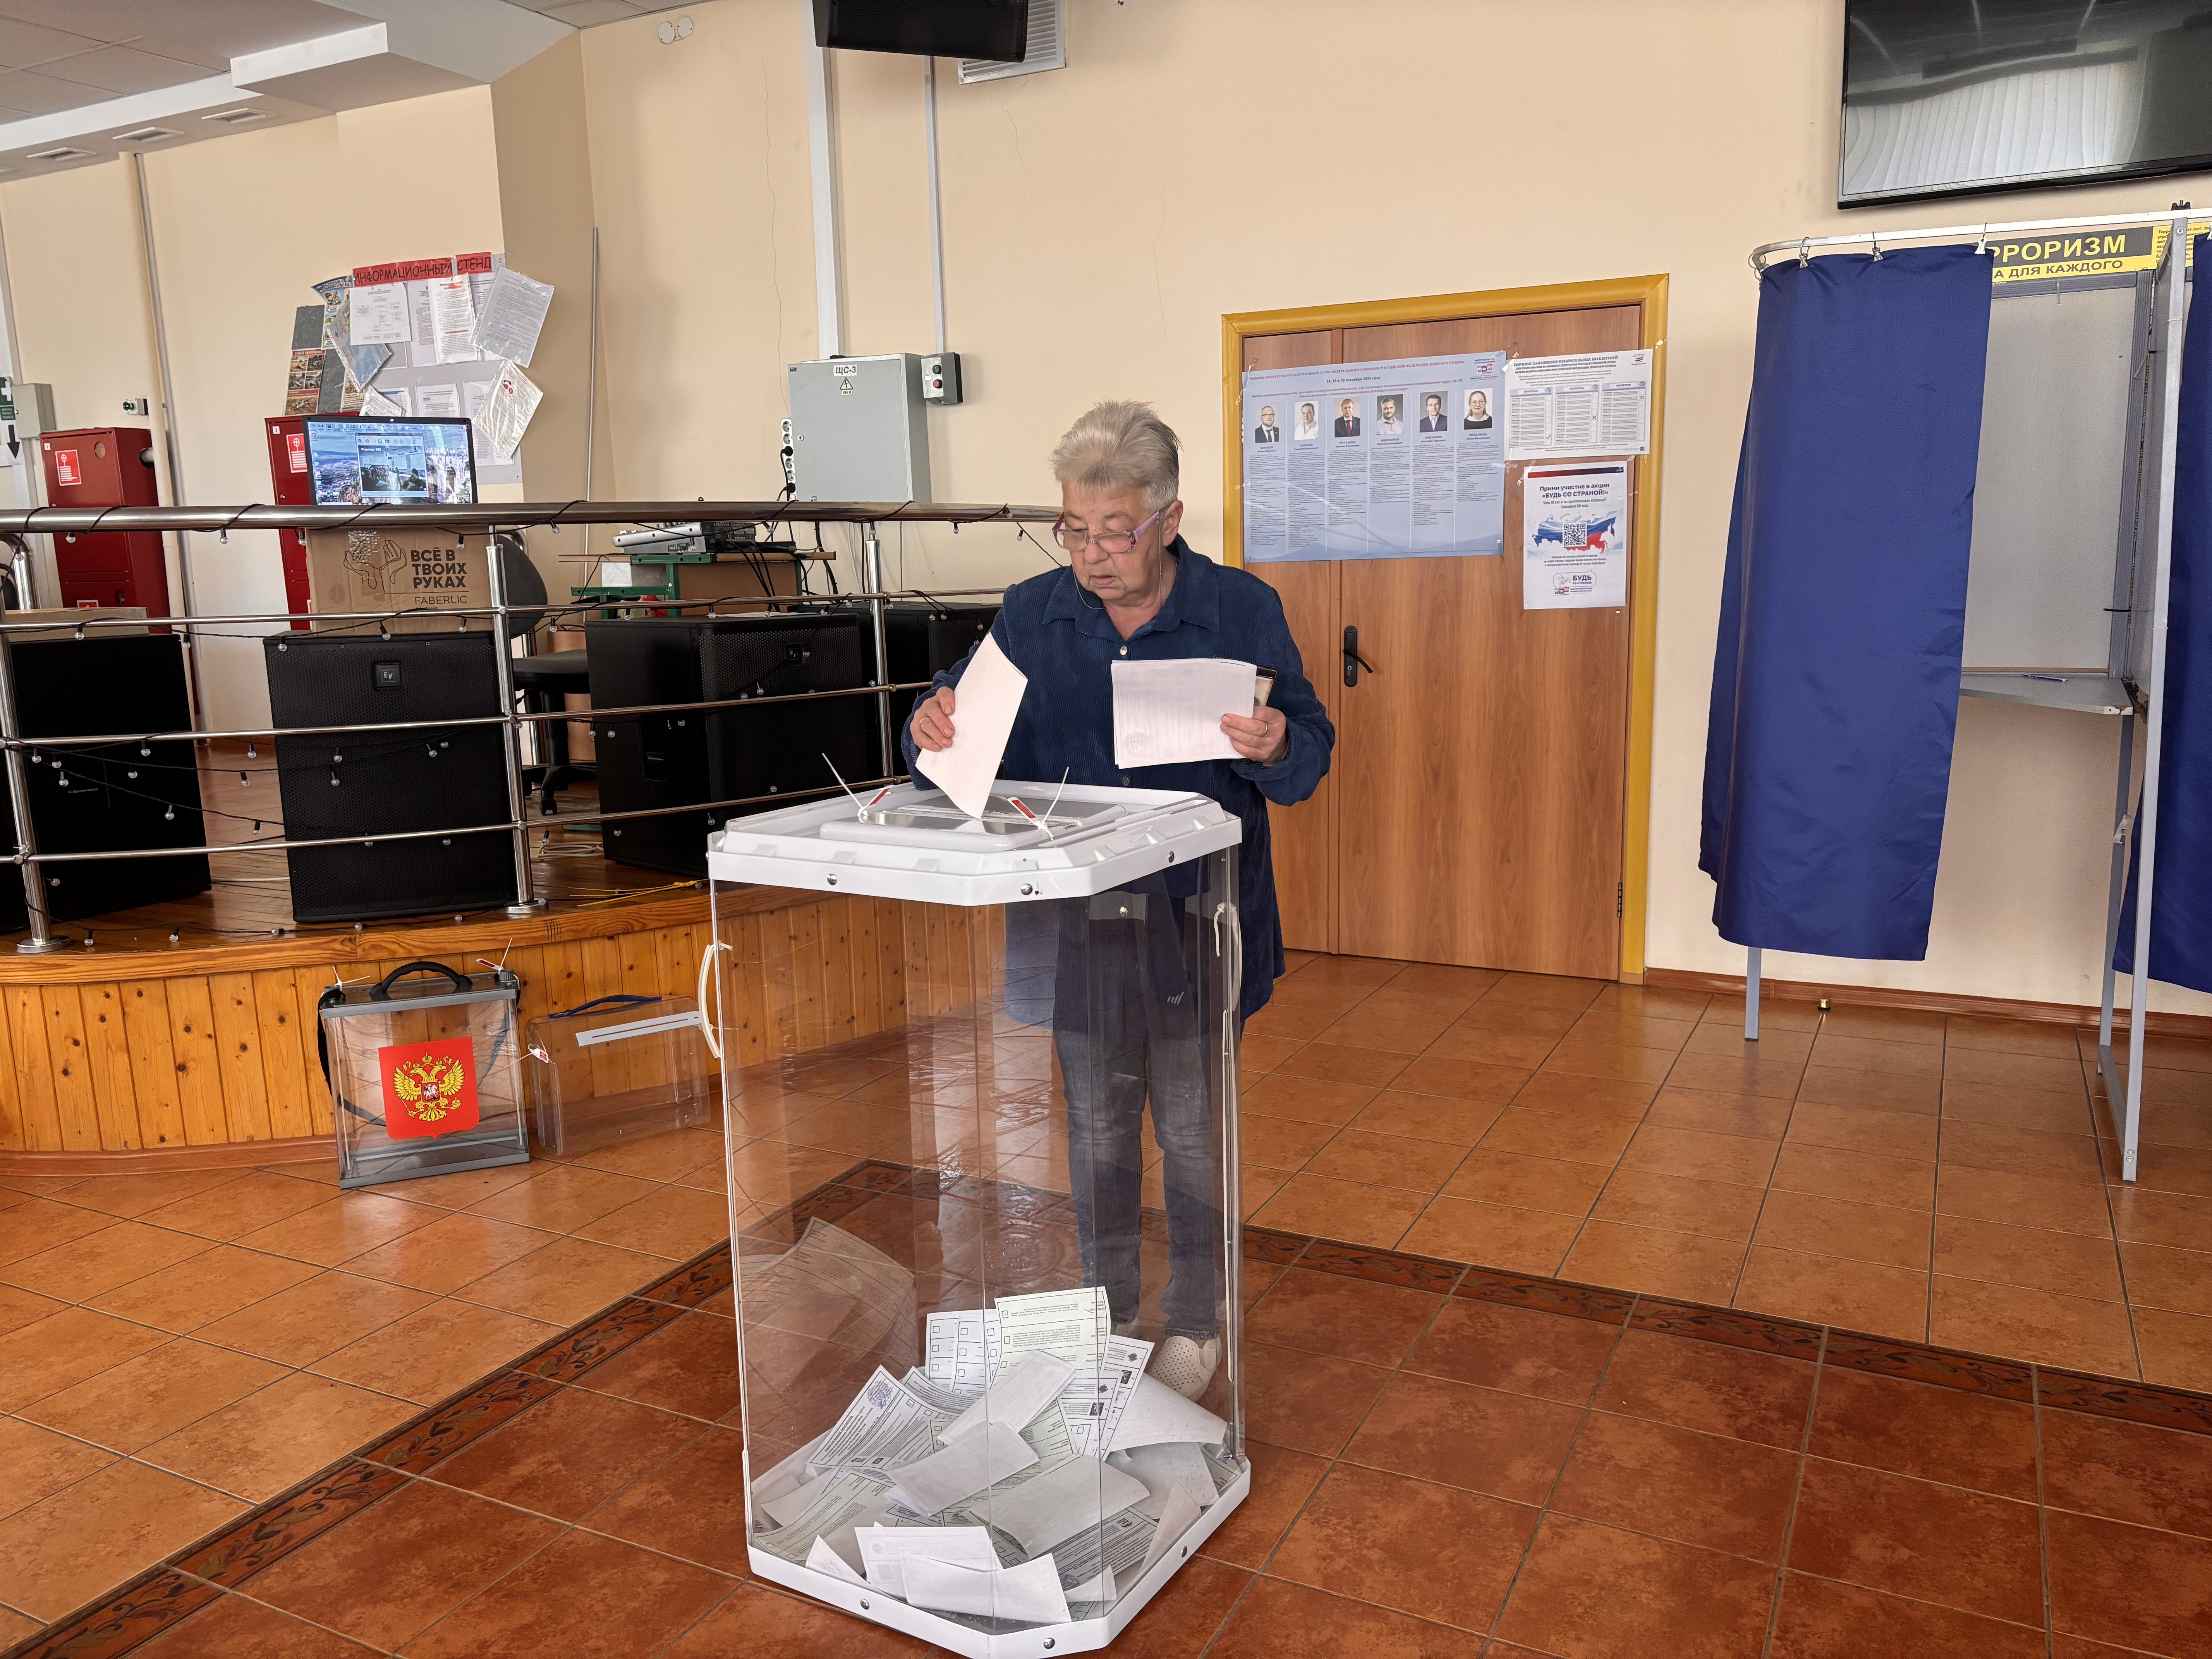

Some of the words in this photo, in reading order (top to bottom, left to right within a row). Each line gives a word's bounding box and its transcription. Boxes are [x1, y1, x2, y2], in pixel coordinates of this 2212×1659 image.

[354, 258, 452, 283] ИНФОРМАЦИОННЫЙ
[457, 257, 492, 271] СТЕНД
[2008, 266, 2040, 278] ДЛЯ
[2046, 260, 2123, 273] КАЖДОГО
[835, 366, 856, 375] ЩС-3
[446, 549, 456, 561] В
[412, 562, 467, 575] ТВОИХ
[413, 576, 466, 589] РУКАХ
[415, 595, 467, 605] FABERLIC
